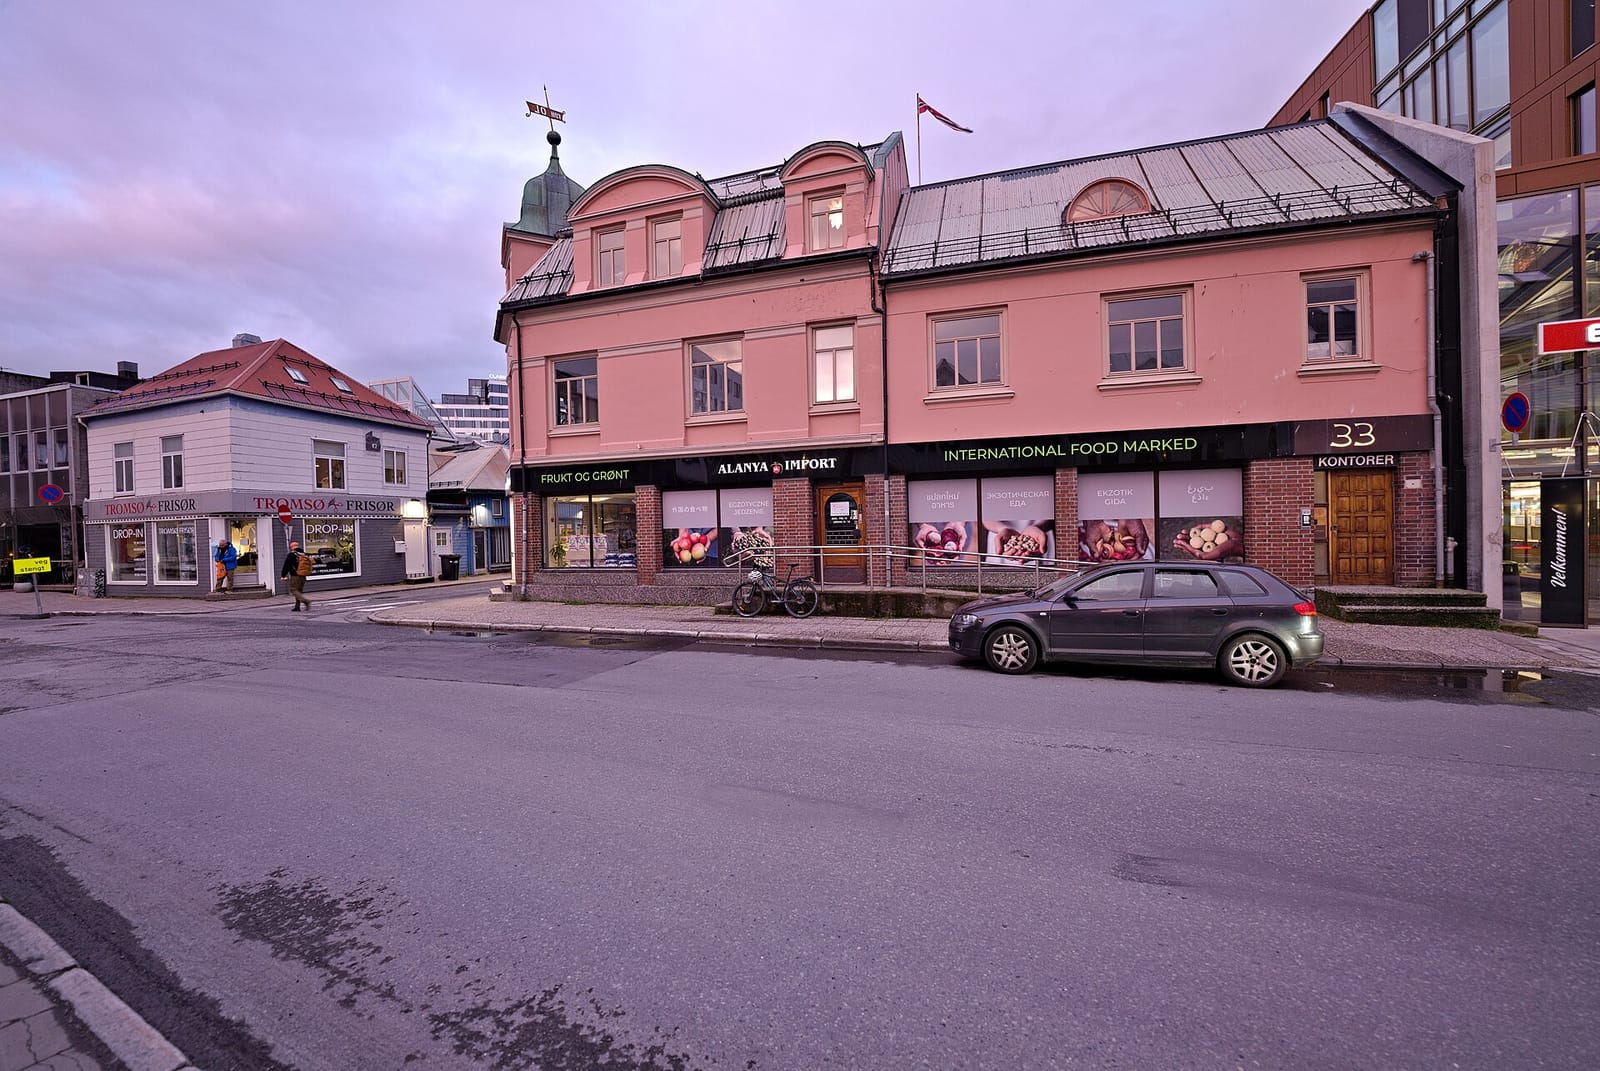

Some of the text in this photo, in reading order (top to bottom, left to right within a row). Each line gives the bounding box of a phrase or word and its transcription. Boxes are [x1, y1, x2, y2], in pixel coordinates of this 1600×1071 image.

[1329, 422, 1376, 448] 33
[944, 437, 1198, 462] INTERNATIONAL FOOD MARKED
[717, 457, 837, 474] ALANYA IMPORT
[1318, 454, 1394, 467] KONTORER
[541, 469, 630, 484] FRUKT OG GRØNT
[986, 490, 1050, 500] ЭКЗОТИЧЕСКАЯ
[1096, 488, 1133, 497] EKZOTIK
[104, 499, 197, 515] TROMSØ FRISØR
[253, 497, 395, 512] TROMSØ FRISØR
[1104, 497, 1127, 505] GIDA
[112, 527, 144, 539] DROP-IN
[306, 524, 354, 534] DROP-IN
[1550, 507, 1567, 588] Velkommen!
